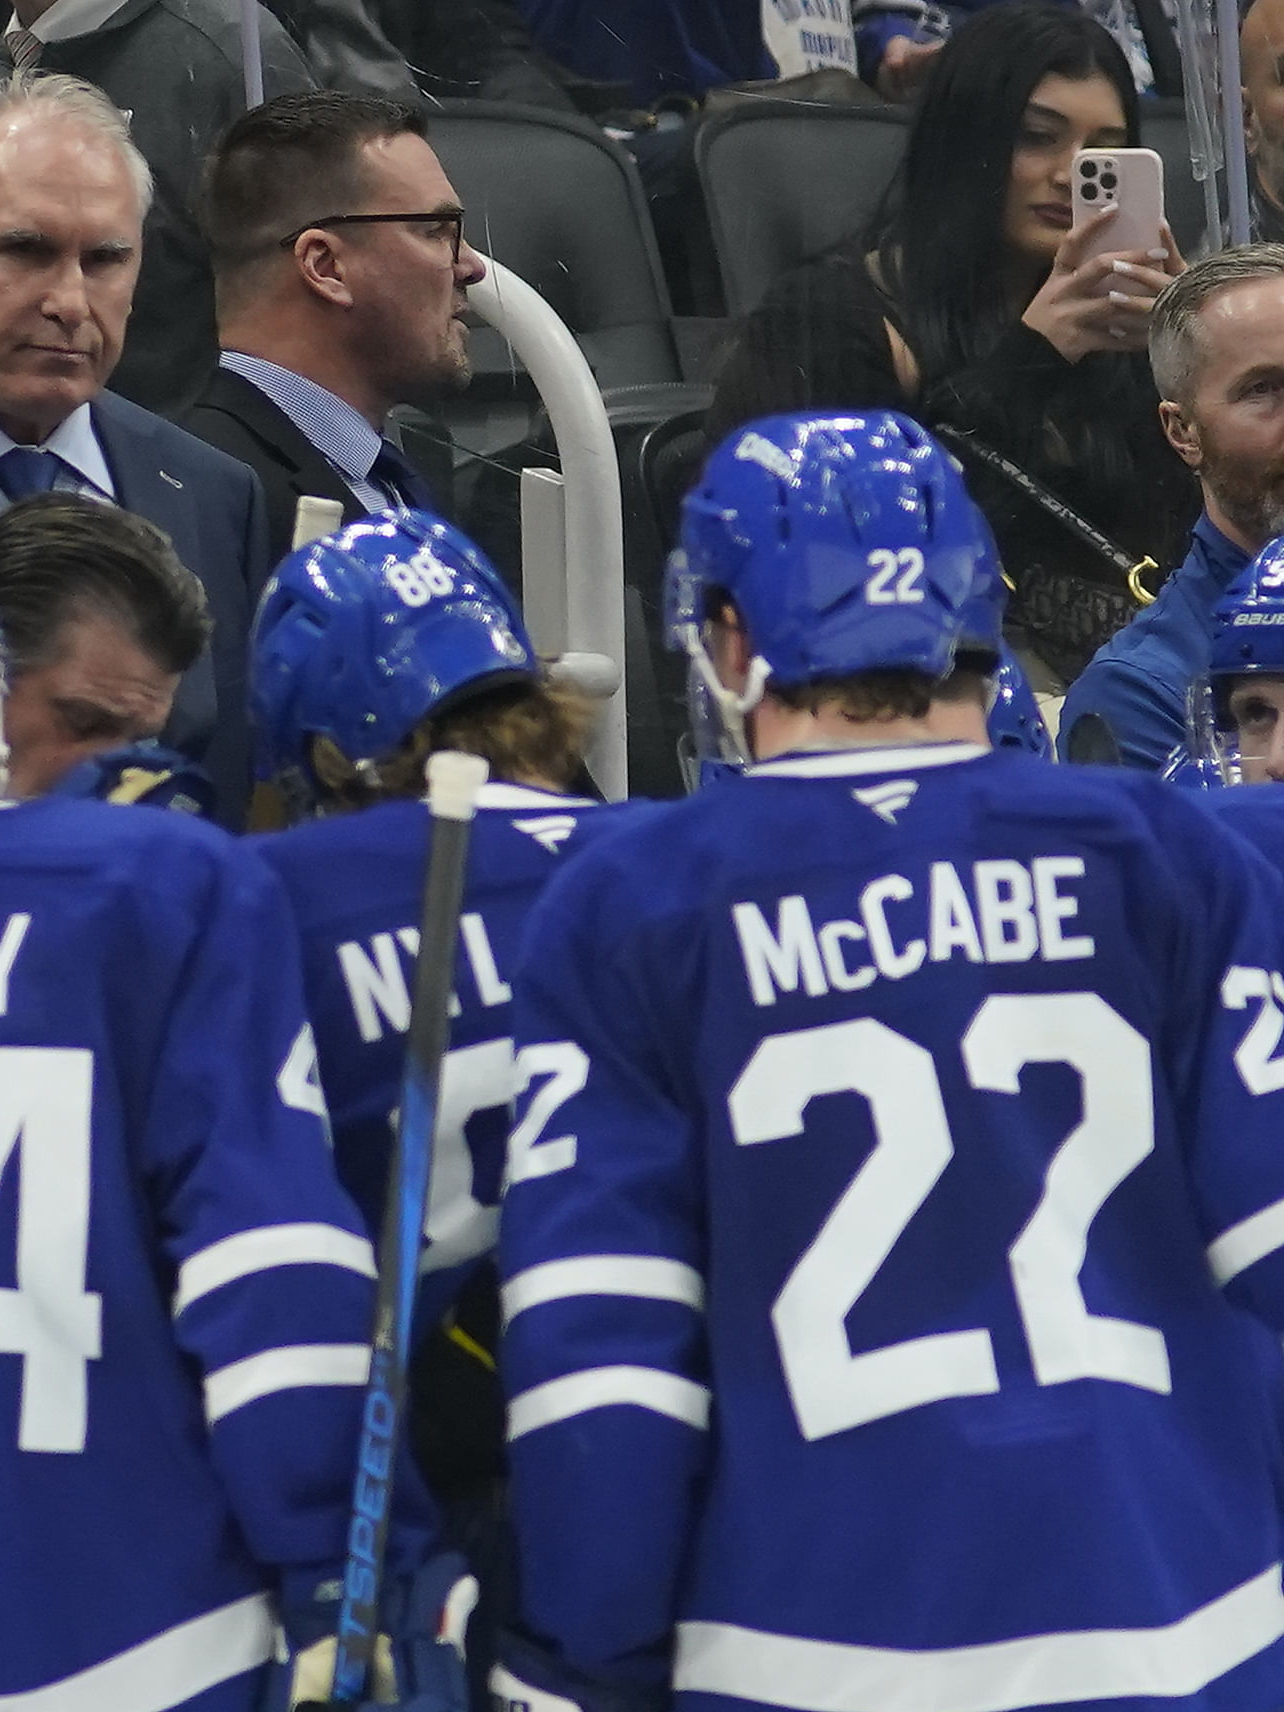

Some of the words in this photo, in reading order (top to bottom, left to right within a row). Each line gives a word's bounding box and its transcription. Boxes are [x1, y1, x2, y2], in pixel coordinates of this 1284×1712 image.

[385, 555, 454, 607] 88
[867, 547, 925, 605] 22
[733, 856, 1095, 1006] McCABE
[727, 991, 1172, 1442] 22
